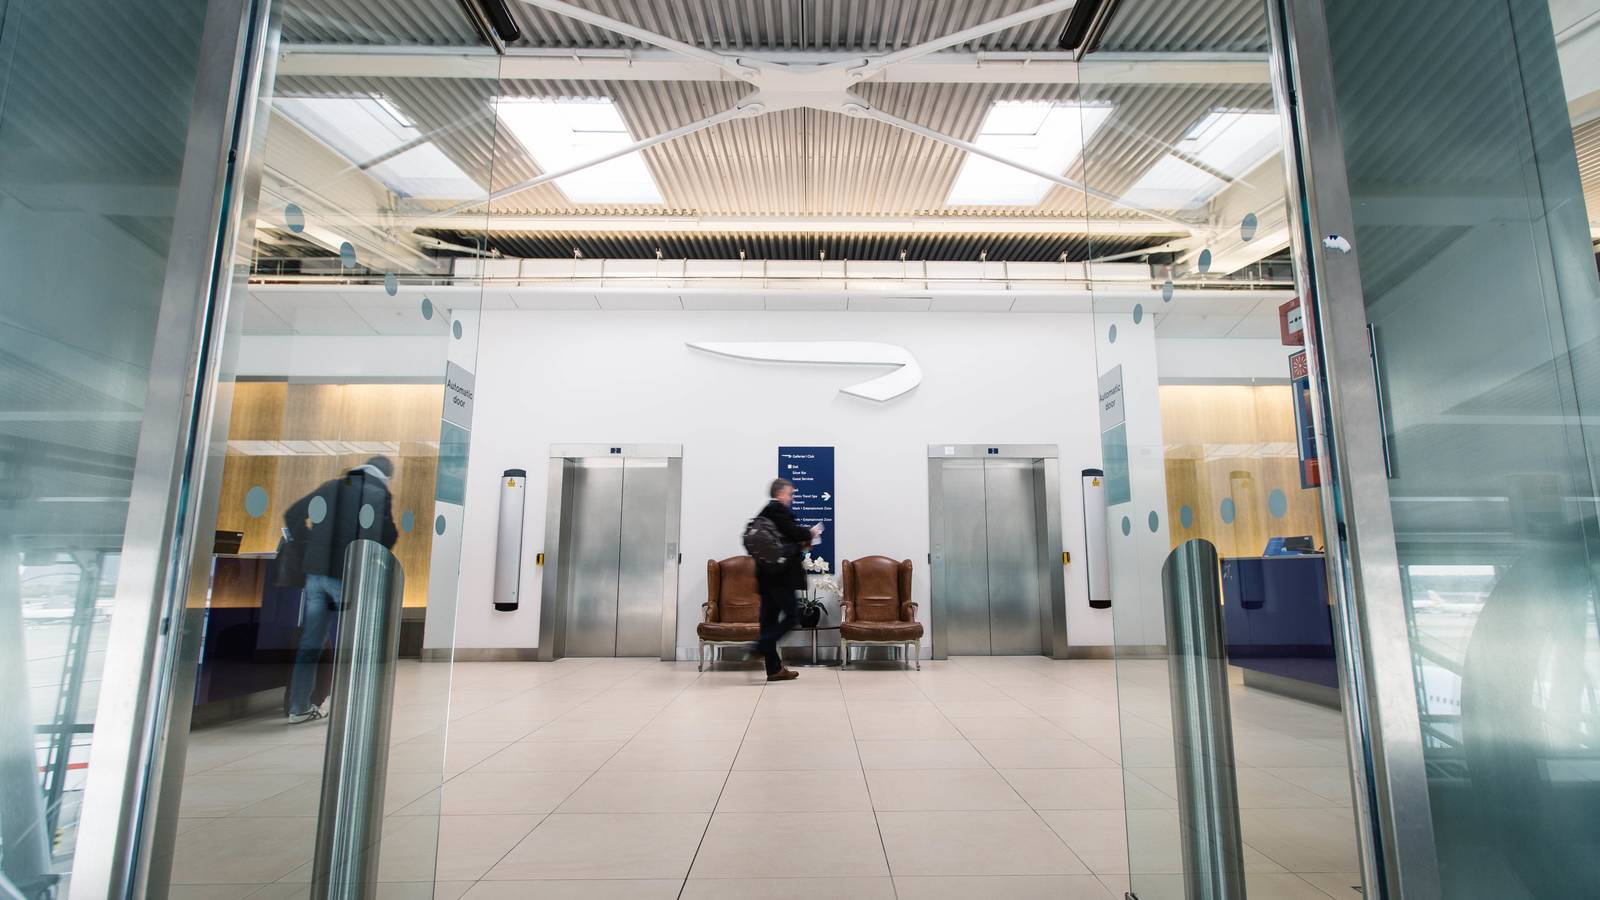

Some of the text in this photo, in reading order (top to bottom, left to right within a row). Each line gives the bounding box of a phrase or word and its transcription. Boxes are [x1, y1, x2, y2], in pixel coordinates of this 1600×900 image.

[446, 379, 473, 400] Automatic
[1099, 384, 1121, 401] Automatic
[452, 395, 466, 407] door
[1105, 400, 1116, 411] door
